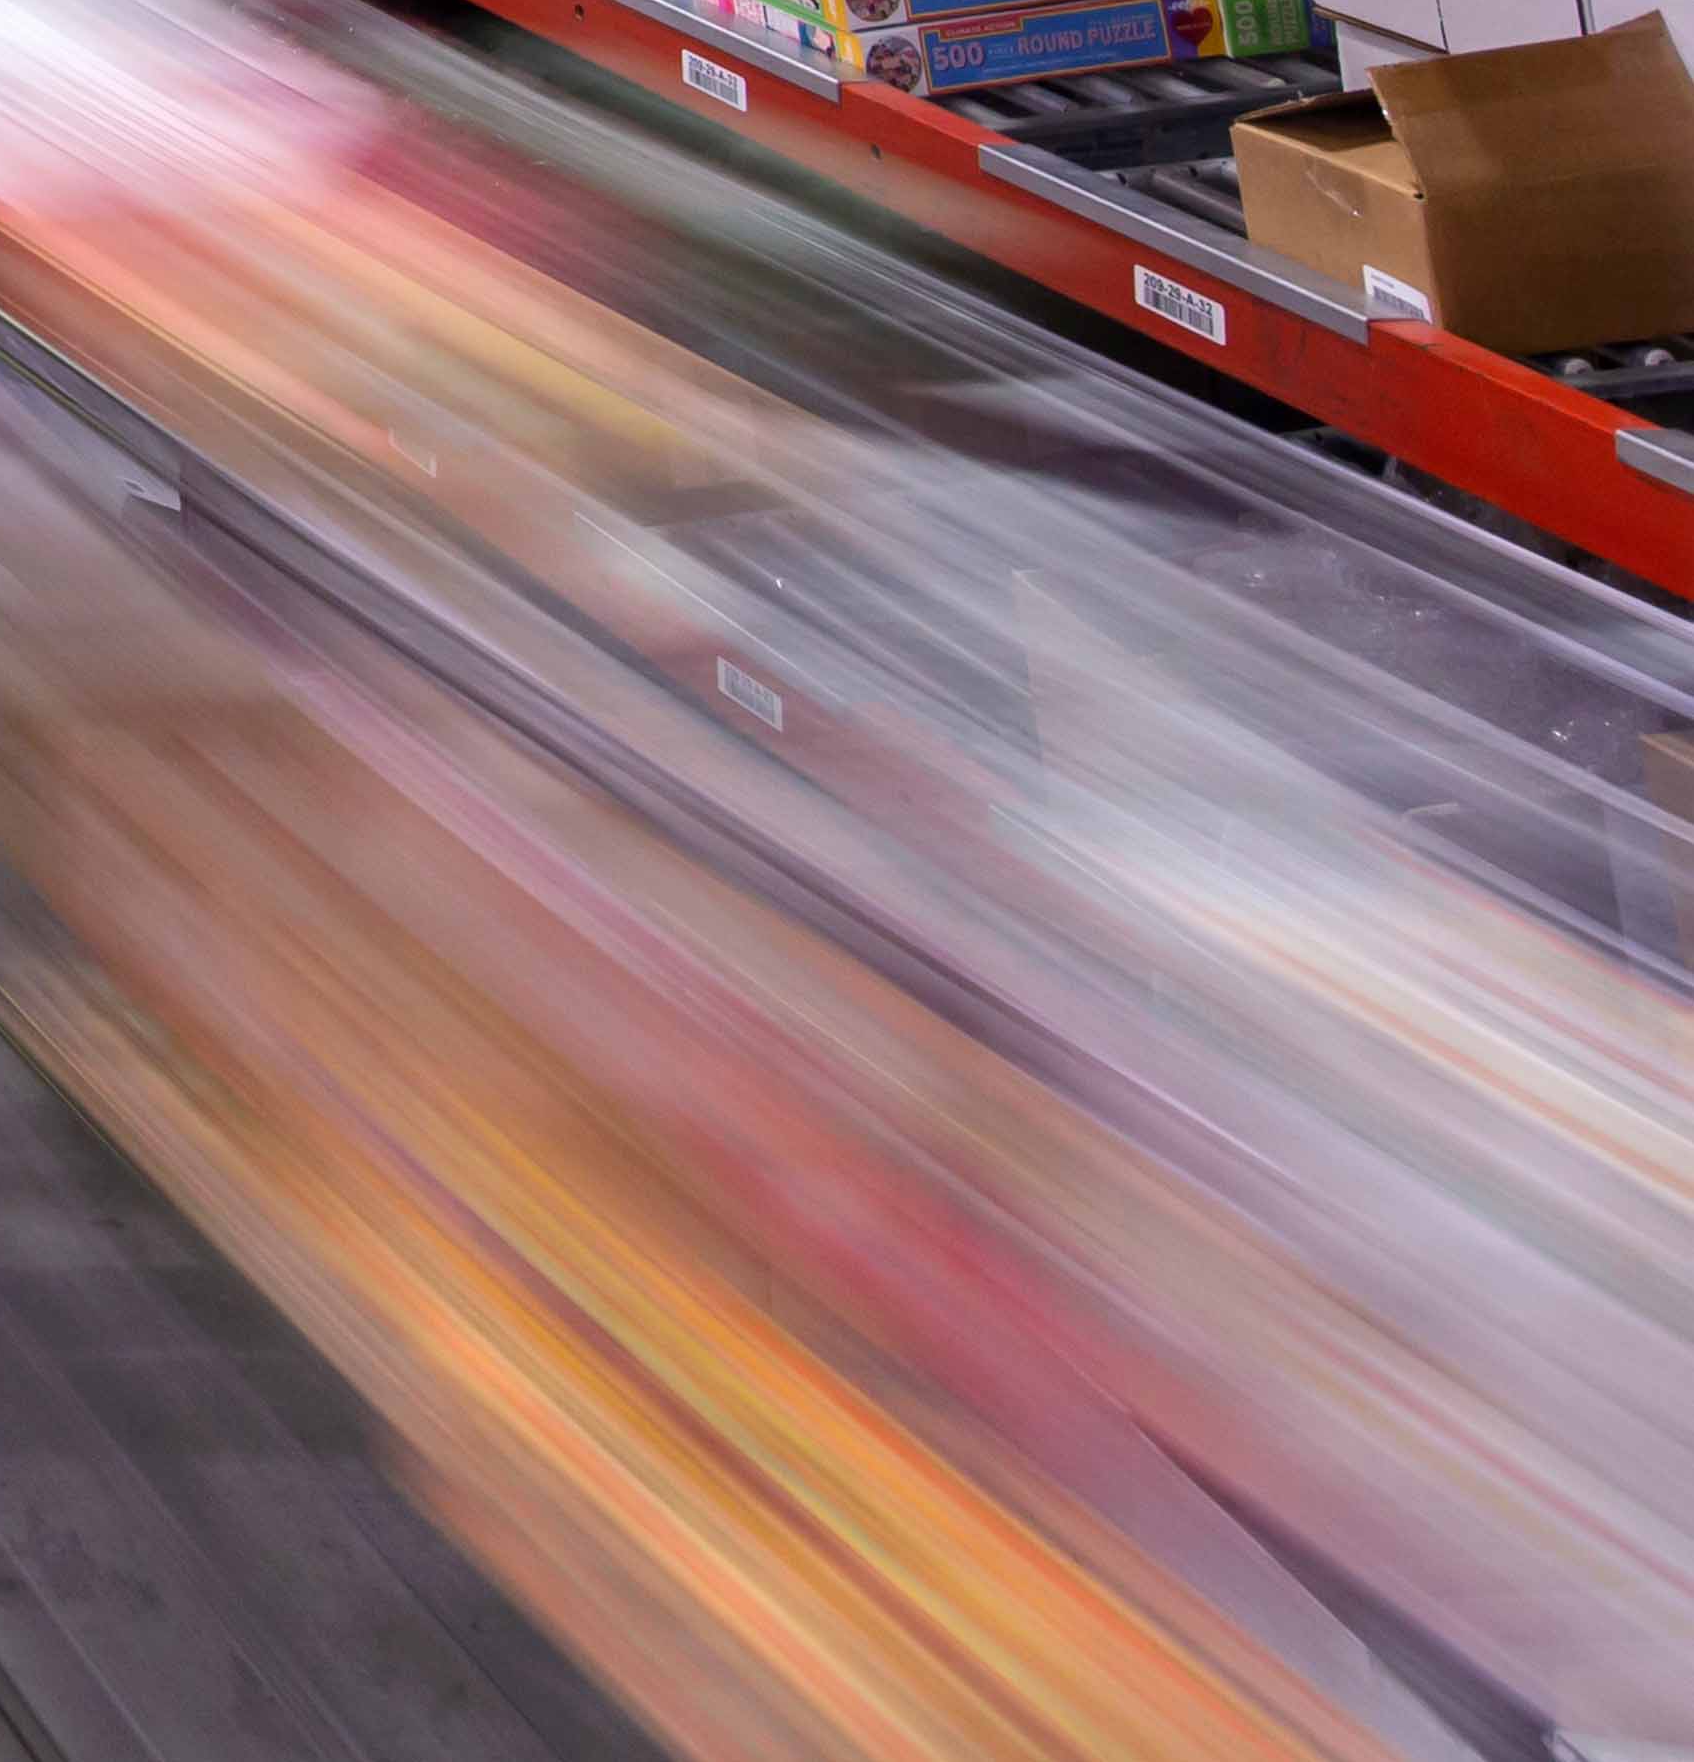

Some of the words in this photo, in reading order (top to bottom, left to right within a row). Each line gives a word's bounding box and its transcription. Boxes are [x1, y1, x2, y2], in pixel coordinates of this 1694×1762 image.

[932, 41, 985, 72] 500
[1017, 30, 1084, 56] ROUND
[1088, 20, 1156, 46] PUZZLE
[1235, 0, 1259, 47] 500
[1142, 271, 1215, 317] 209-29-A-32
